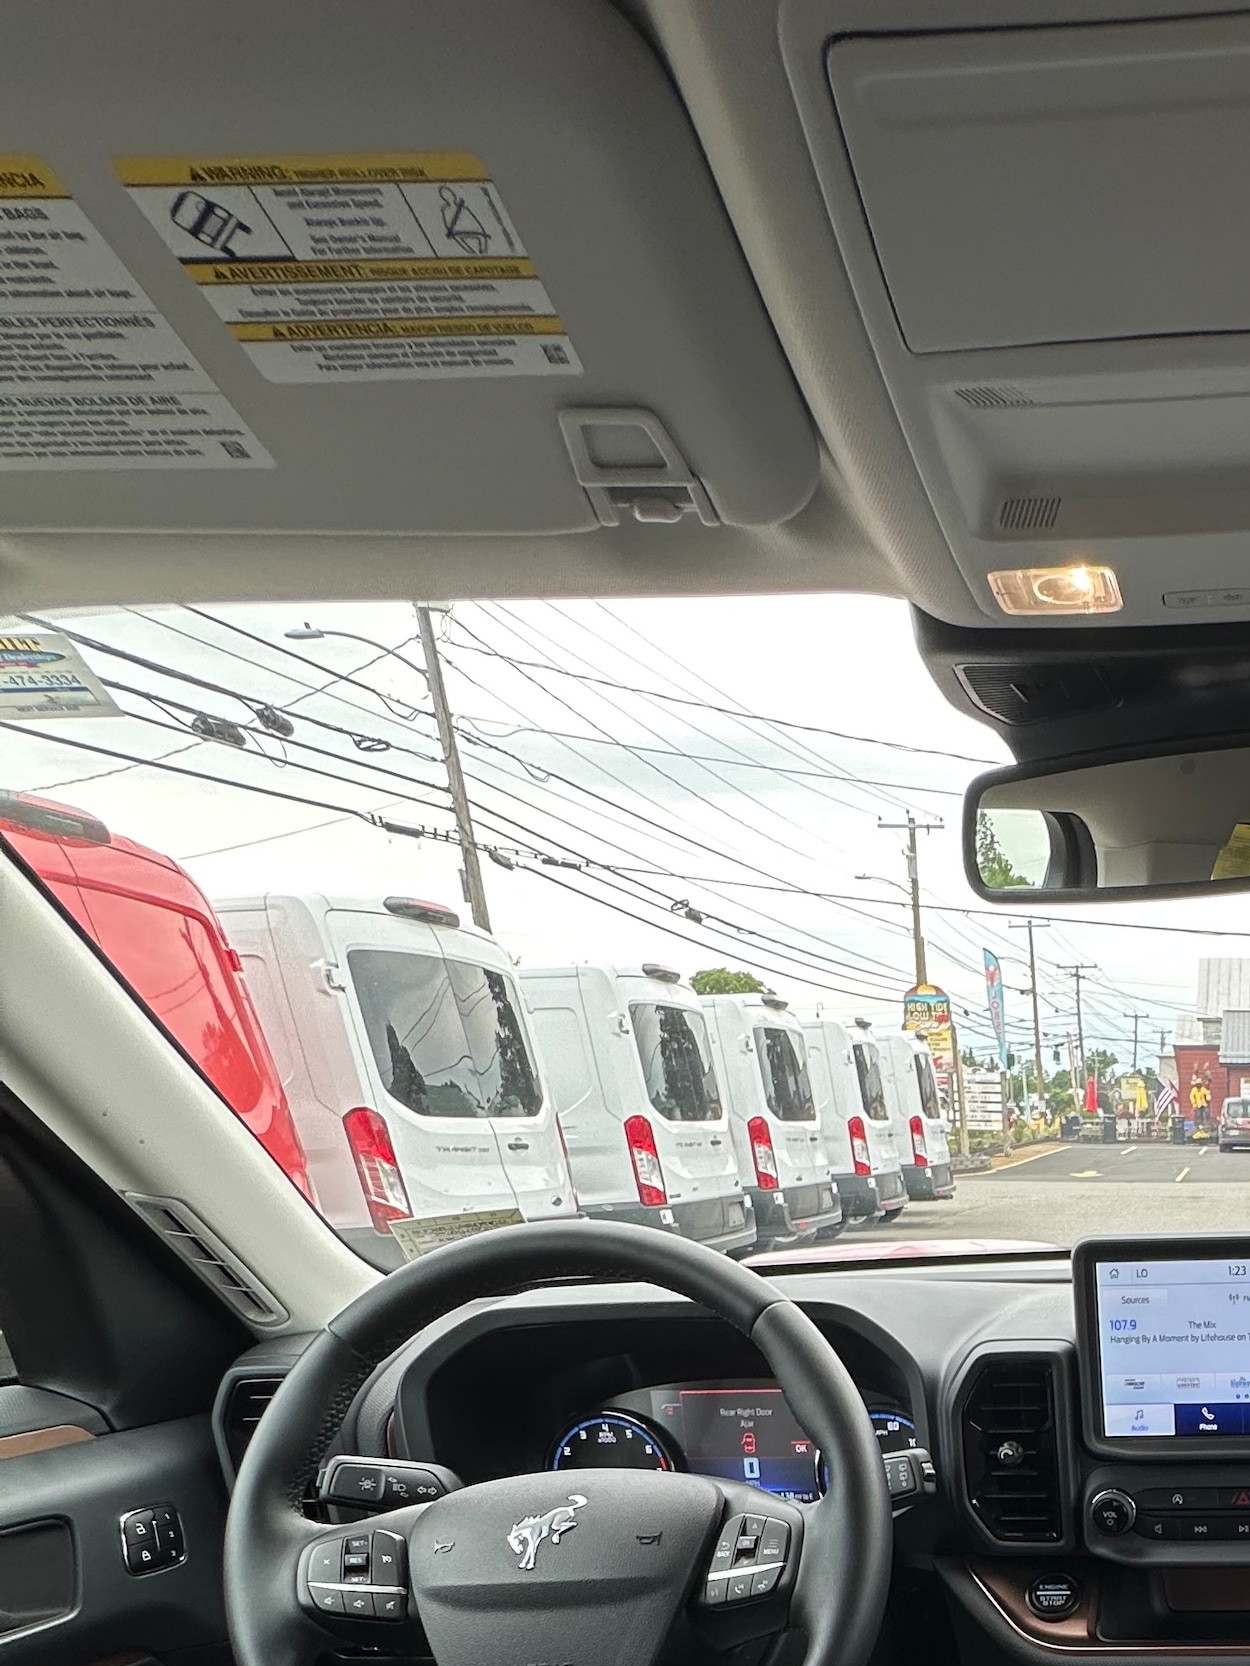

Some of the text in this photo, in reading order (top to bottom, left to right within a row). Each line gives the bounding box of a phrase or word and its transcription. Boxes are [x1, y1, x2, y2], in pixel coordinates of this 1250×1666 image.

[1136, 1268, 1148, 1278] LO
[1228, 1265, 1246, 1277] 1:23
[1121, 1295, 1150, 1305] Sources
[1109, 1319, 1137, 1331] 107.9
[1189, 1320, 1217, 1330] The Mix
[1110, 1335, 1140, 1345] Hanging
[1159, 1334, 1189, 1342] Moment
[1191, 1333, 1199, 1343] by
[1201, 1333, 1235, 1342] Lifehouse
[720, 1407, 773, 1418] Rear Right Door
[601, 1423, 609, 1432] 4
[1131, 1424, 1149, 1432] Audio
[1199, 1423, 1218, 1431] Phone
[579, 1430, 587, 1440] 3
[625, 1429, 633, 1439] 5
[563, 1447, 571, 1456] 2
[645, 1445, 653, 1455] 6
[795, 1444, 807, 1453] OK
[1103, 1511, 1117, 1519] VOL
[717, 1550, 730, 1558] BACK
[763, 1548, 779, 1556] MENU
